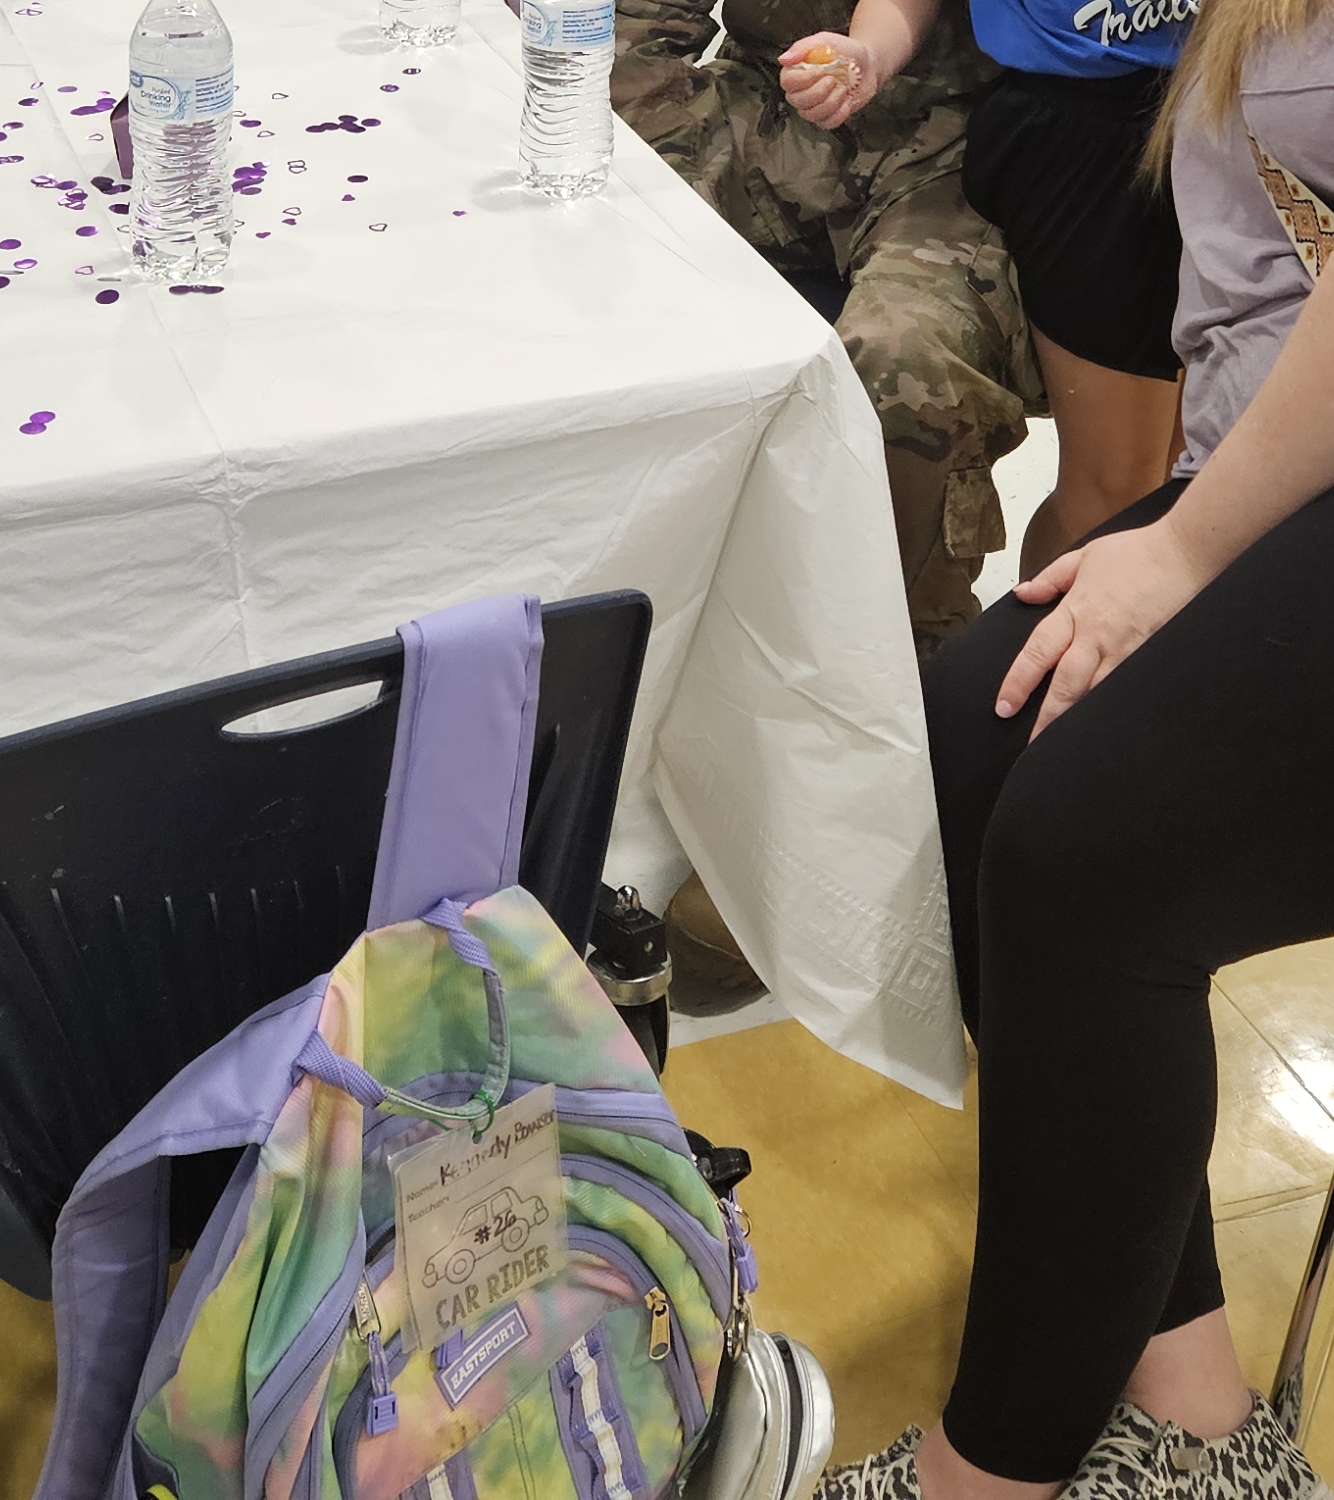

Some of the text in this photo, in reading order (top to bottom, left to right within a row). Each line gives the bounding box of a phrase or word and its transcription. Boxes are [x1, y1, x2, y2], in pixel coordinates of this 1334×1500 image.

[140, 90, 171, 103] Drinking
[149, 100, 171, 109] Water
[436, 1244, 550, 1330] CAR RIDER
[451, 1321, 516, 1390] EASTSPORT
